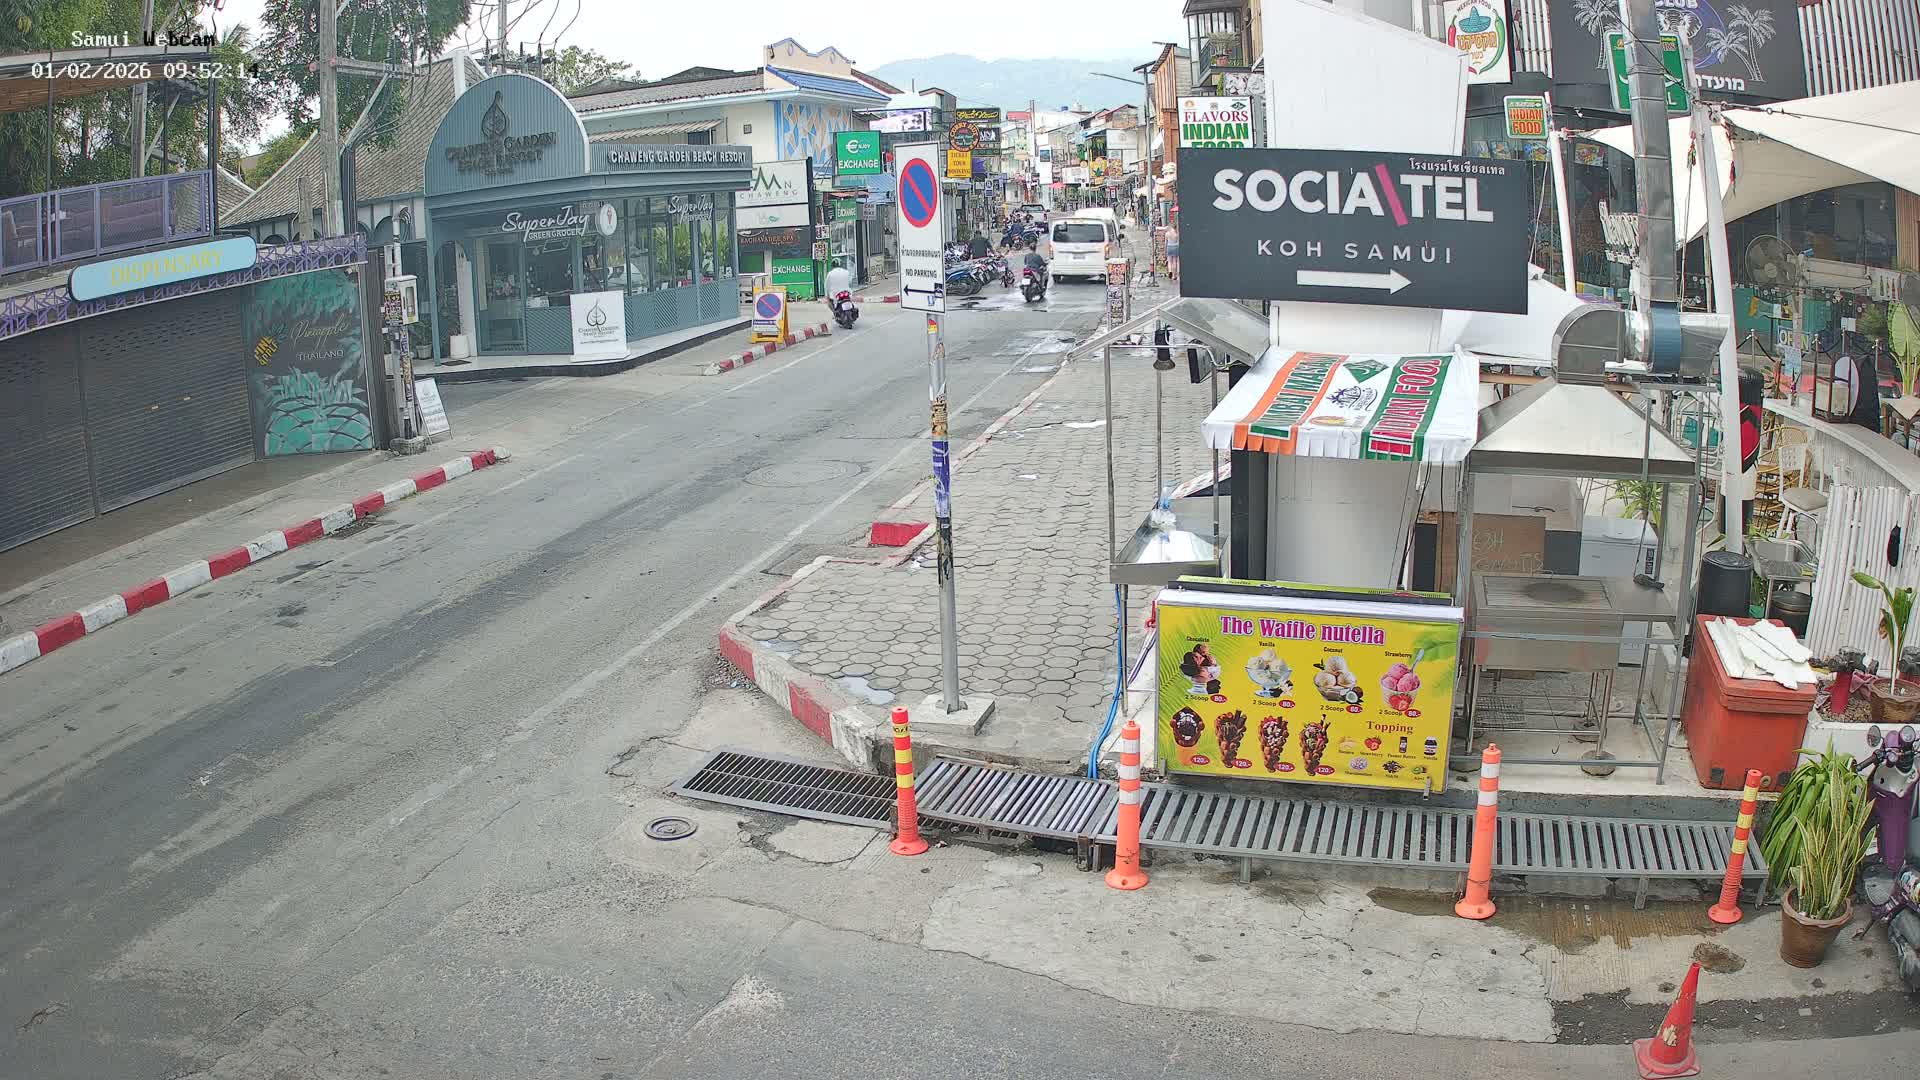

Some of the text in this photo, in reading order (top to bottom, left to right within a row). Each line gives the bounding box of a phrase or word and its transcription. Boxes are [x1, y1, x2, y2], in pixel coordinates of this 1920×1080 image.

[1184, 111, 1249, 122] FLAVORS
[1510, 109, 1543, 120] INDIAN
[1183, 123, 1249, 140] INDIAN
[1512, 121, 1542, 134] FOOD
[610, 150, 747, 163] CHAWENG GARDEN BEACH RESORT
[838, 160, 879, 169] EXCHANGE
[740, 190, 798, 200] CHAWENG
[837, 208, 857, 218] EXCHANGE
[501, 205, 590, 243] SuperJay
[528, 229, 551, 240] GREEN
[1256, 239, 1452, 265] KOH SAMUI
[111, 248, 226, 288] DISPENSARY
[772, 265, 811, 274] EXCHANGE
[906, 269, 938, 279] NO PARKING
[289, 312, 350, 352] Pineapple
[1780, 329, 1809, 352] OPN
[297, 349, 344, 361] THAILAND
[1220, 616, 1386, 647] The Waffle nutella
[1323, 646, 1343, 654] Coconut
[1384, 651, 1412, 659] Strawberry
[1367, 721, 1414, 736] Topping
